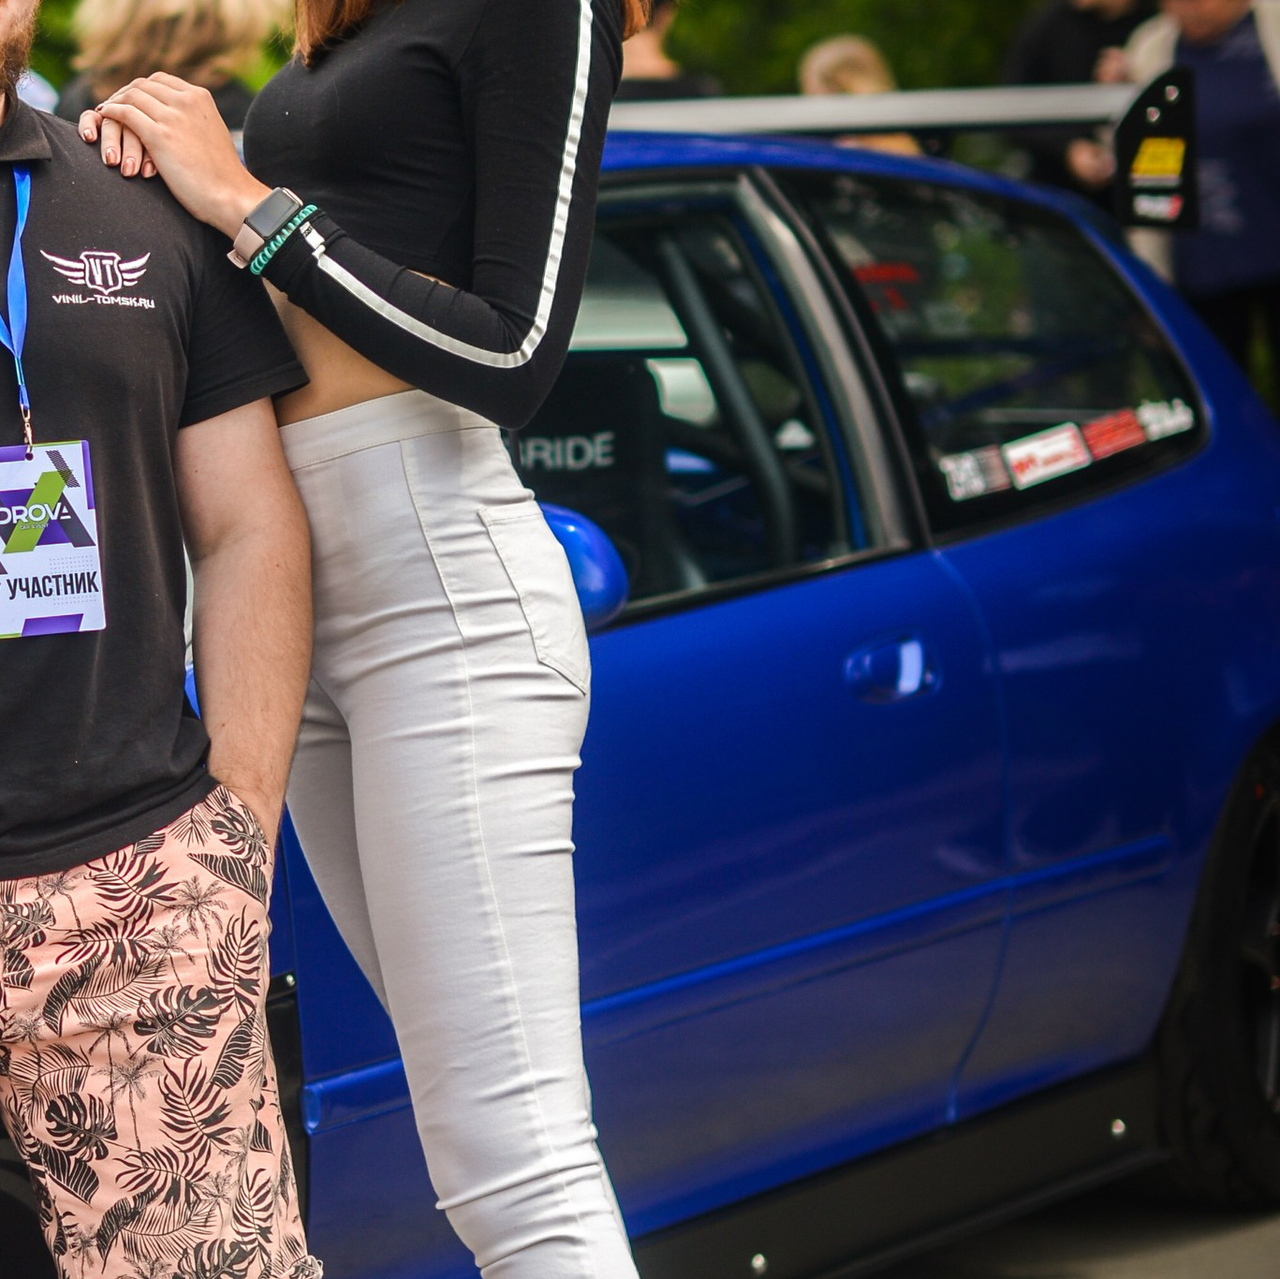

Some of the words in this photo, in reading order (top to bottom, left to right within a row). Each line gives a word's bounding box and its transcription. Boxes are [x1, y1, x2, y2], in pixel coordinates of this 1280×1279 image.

[89, 257, 114, 286] VT
[52, 293, 156, 310] VINIL-TOMSK.RU
[519, 431, 615, 471] RIDE
[6, 570, 100, 601] УЧАСТНИК
